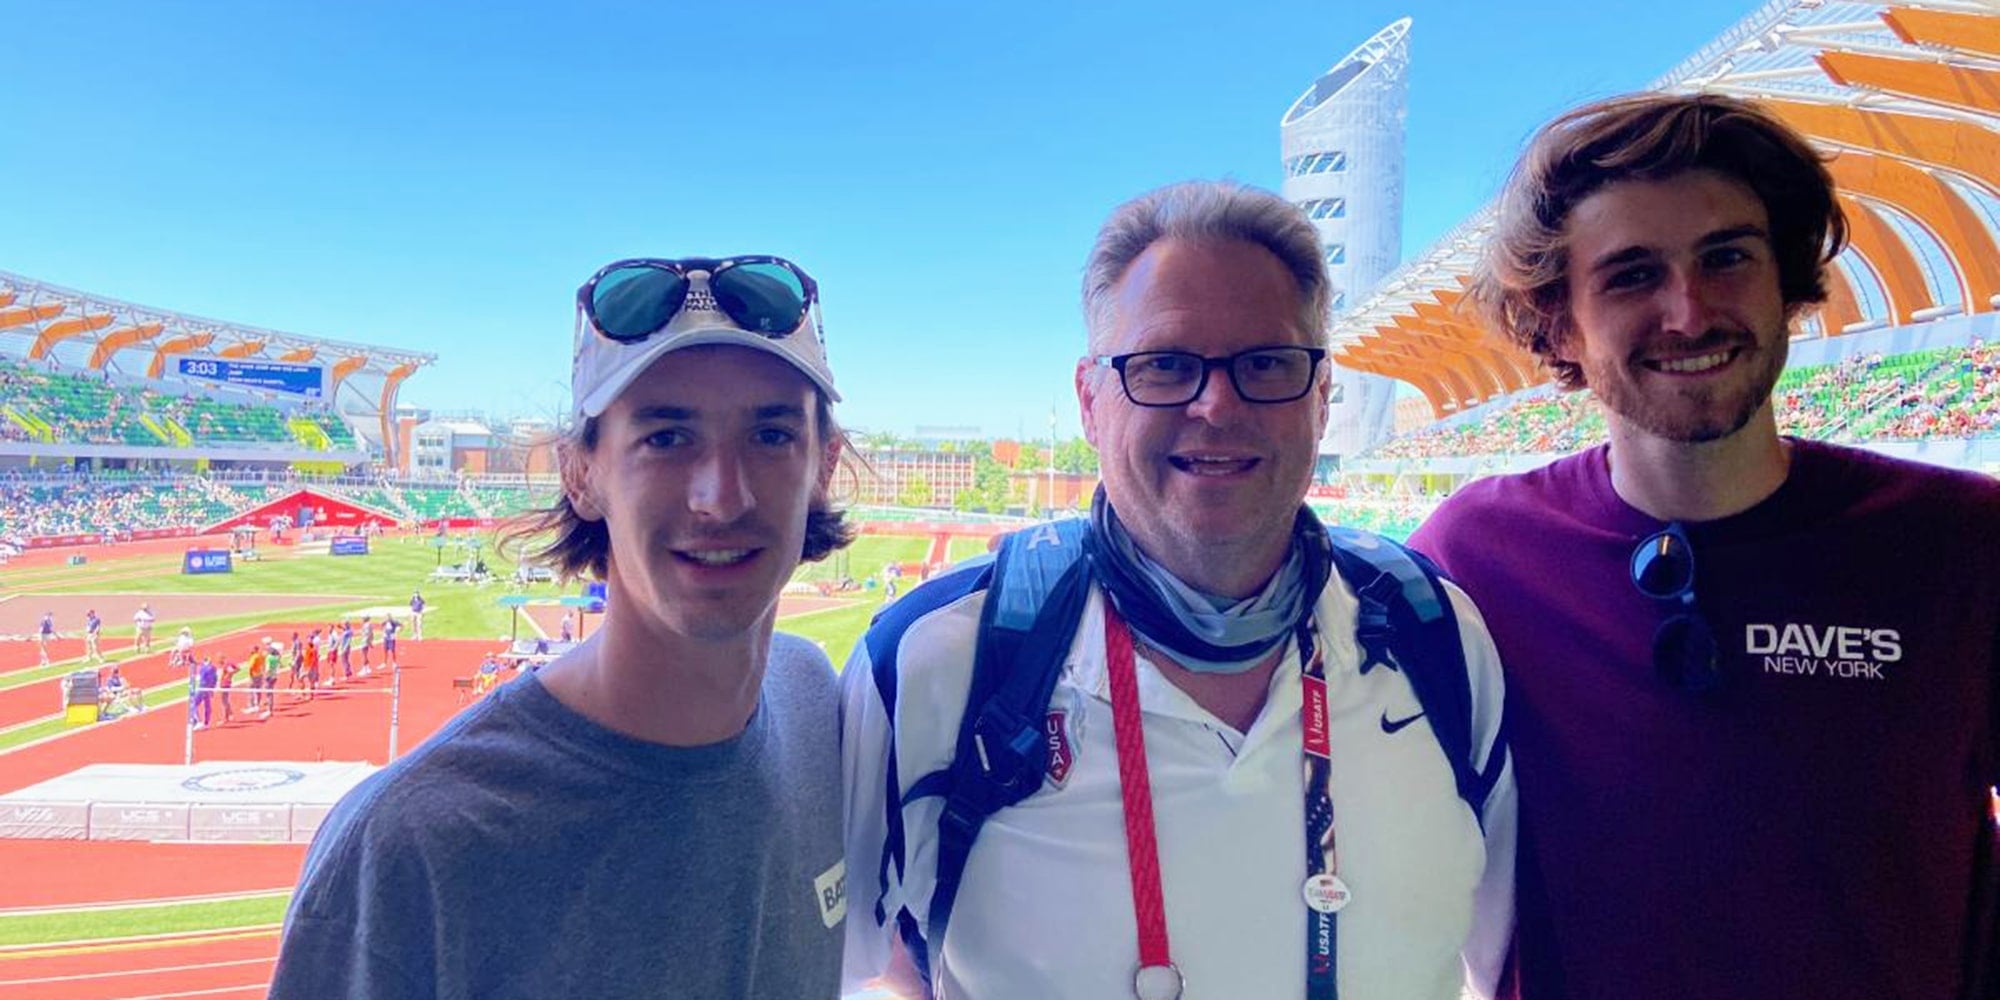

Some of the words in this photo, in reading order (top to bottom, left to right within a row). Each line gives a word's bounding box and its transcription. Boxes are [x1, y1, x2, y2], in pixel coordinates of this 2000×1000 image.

[187, 361, 217, 375] 3:03
[1746, 623, 1902, 662] DAVE'S
[1764, 656, 1818, 675] NEW
[1824, 660, 1885, 679] YORK
[1312, 690, 1323, 728] USATF
[1047, 720, 1064, 766] USA
[221, 811, 261, 824] UCS
[1319, 912, 1331, 955] USATF
